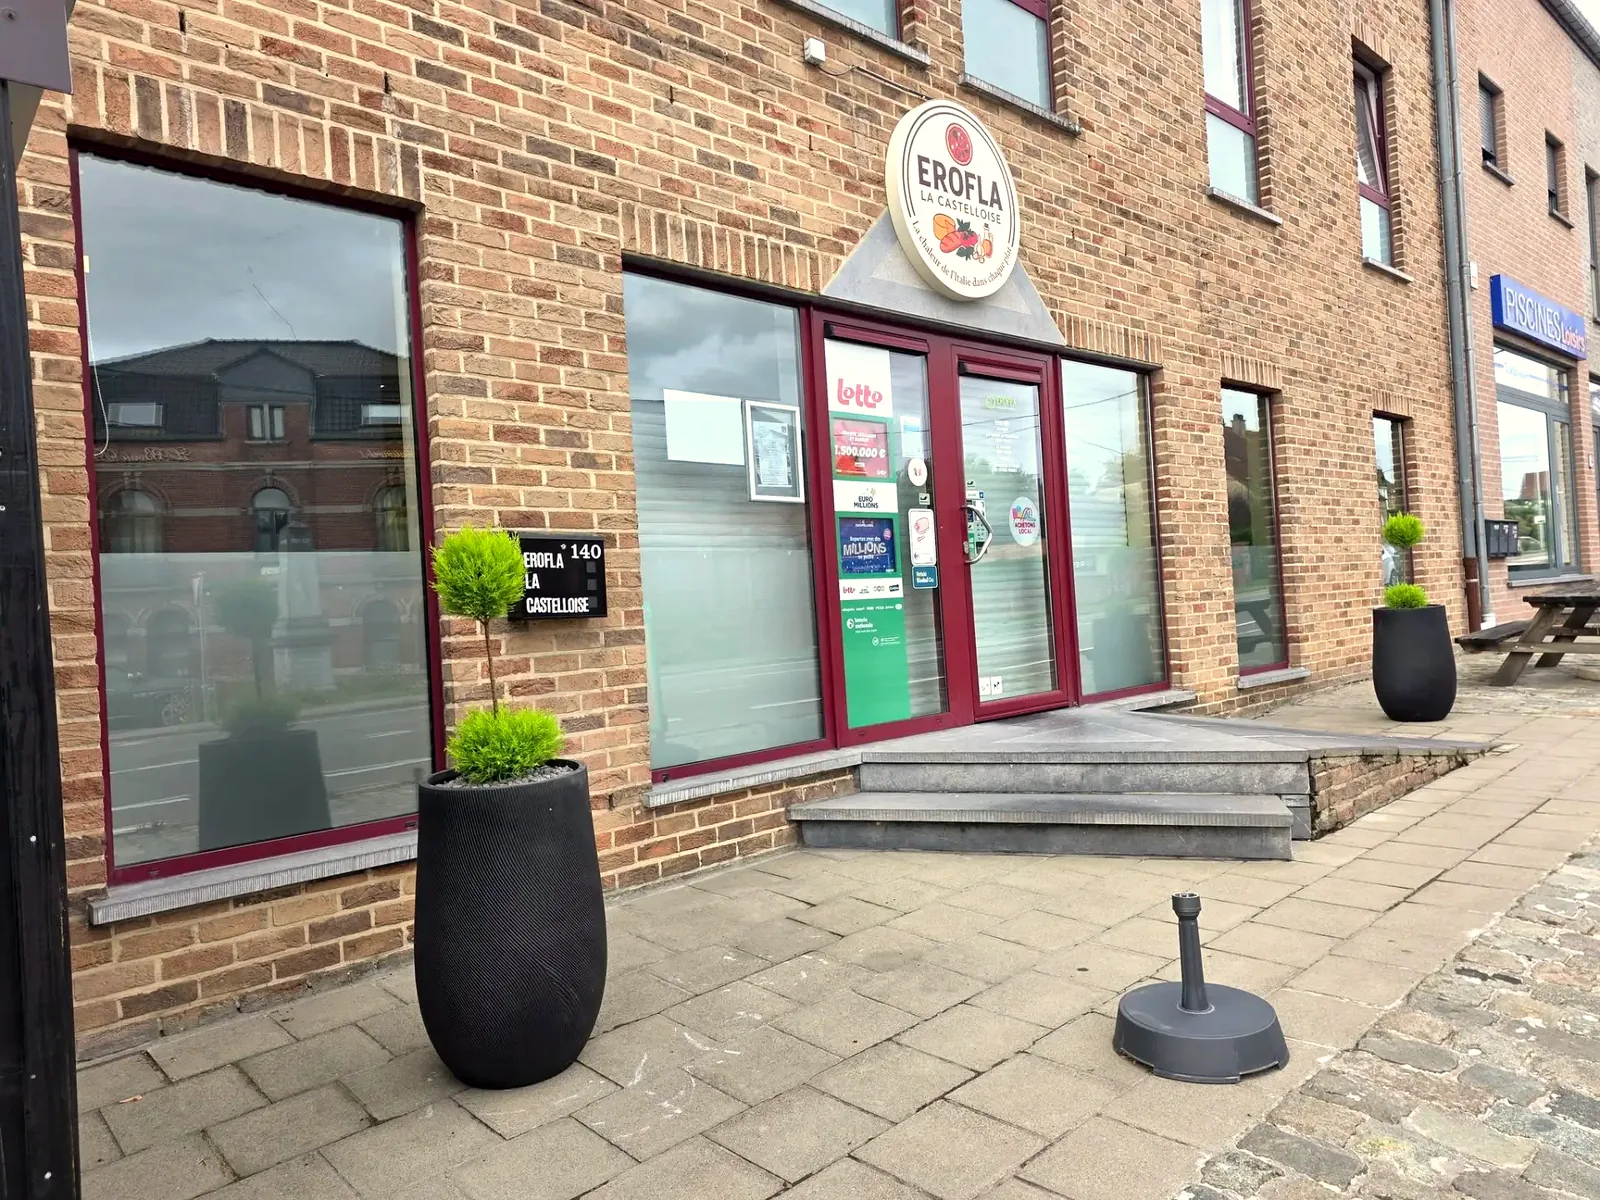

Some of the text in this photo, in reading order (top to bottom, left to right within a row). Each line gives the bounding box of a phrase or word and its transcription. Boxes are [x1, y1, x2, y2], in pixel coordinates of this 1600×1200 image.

[917, 154, 1003, 211] EROFLA
[920, 190, 1001, 224] LA CASTELLOISE
[912, 220, 1013, 287] La chaleur de l'Italie dans chaque plat
[1504, 286, 1585, 353] PISCINES Loisirs
[834, 444, 877, 458] 1.500.000
[571, 543, 602, 559] 140
[843, 541, 887, 556] MILLIONS
[523, 552, 564, 569] EROFLA
[525, 573, 540, 589] LA
[526, 597, 589, 613] CASTELLOISE
